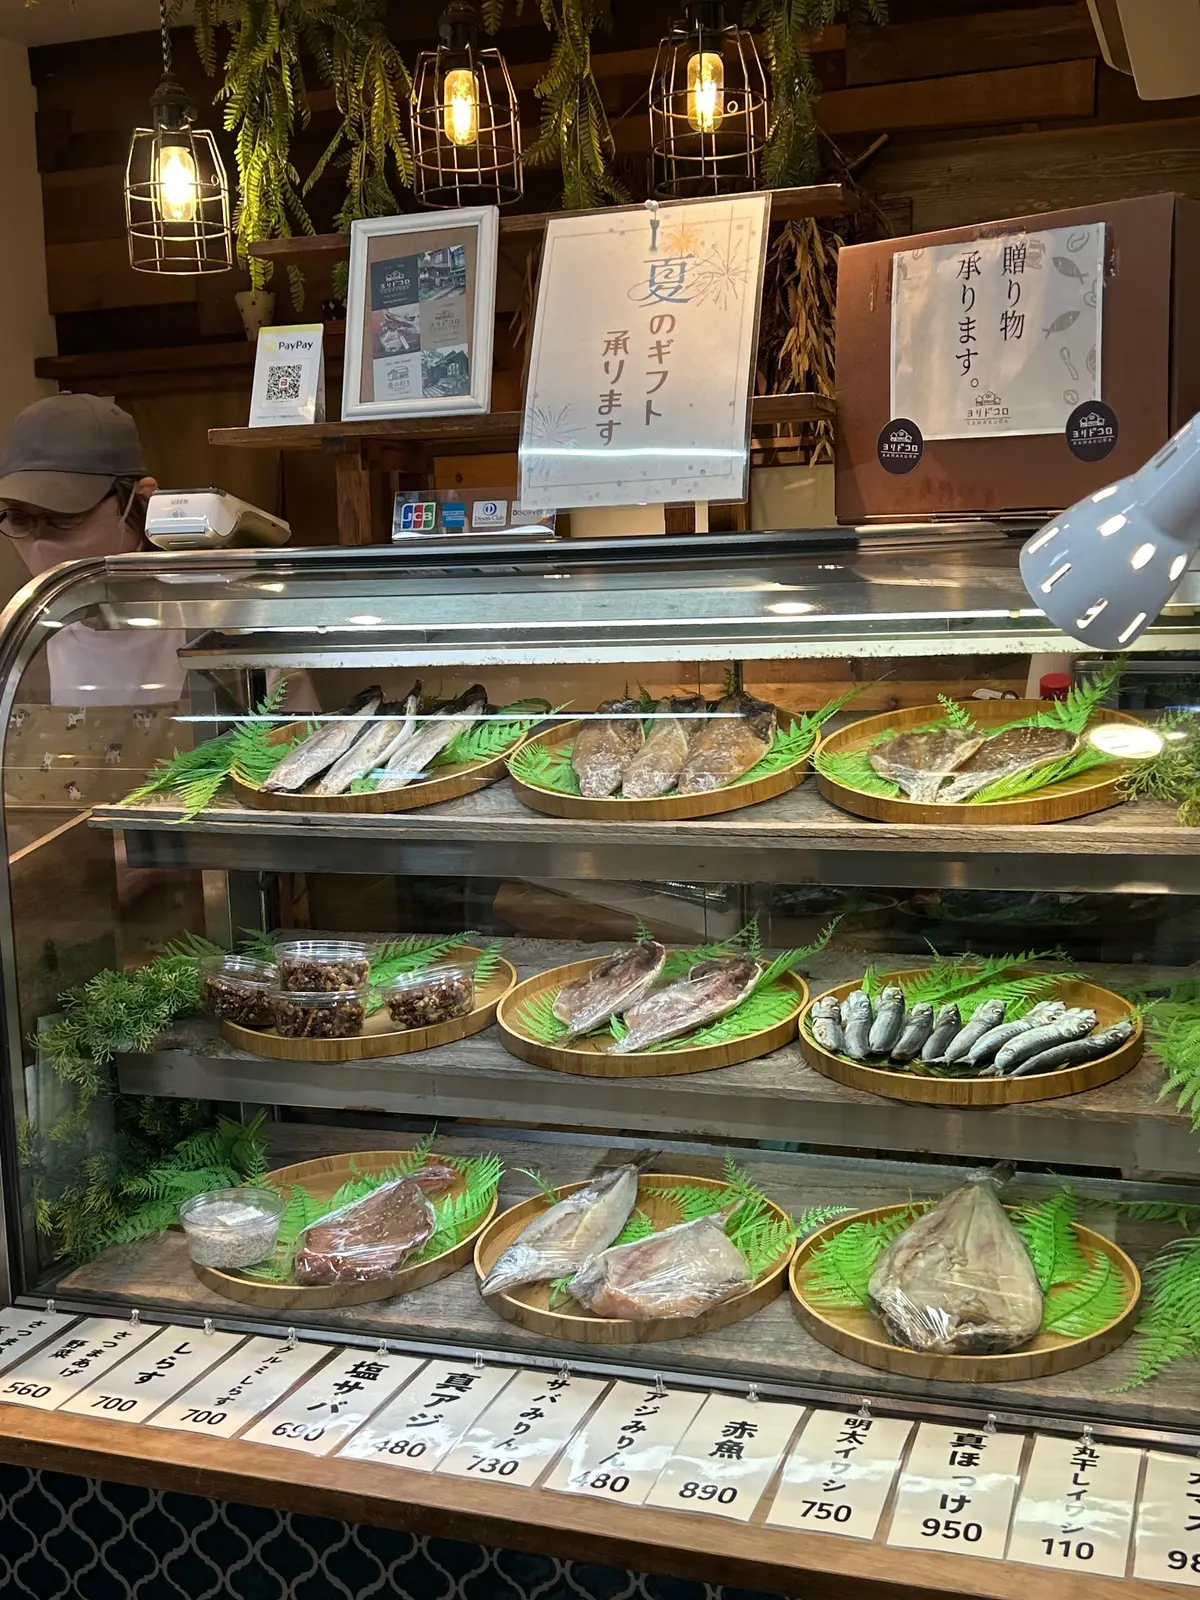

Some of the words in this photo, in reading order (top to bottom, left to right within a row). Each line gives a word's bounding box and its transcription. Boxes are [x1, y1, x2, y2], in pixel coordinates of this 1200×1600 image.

[1000, 242, 1027, 341] 贈り物
[955, 250, 982, 388] 承ります。
[278, 340, 314, 351] PayPay
[637, 253, 696, 426] 夏のギフト
[596, 329, 631, 446] 承ります
[967, 407, 1009, 418] ヨリドコロ
[1072, 426, 1113, 438] ヨリドコロ
[1072, 438, 1113, 446] KAMAKURA
[883, 443, 918, 452] ヨリドコロ
[58, 1331, 132, 1377] さつまあげ
[134, 1341, 192, 1385] しらす
[214, 1345, 294, 1406] クルミしらす
[307, 1359, 390, 1414] 塩サバ
[2, 1382, 52, 1398] 560
[406, 1371, 481, 1428] 真アジ
[90, 1395, 138, 1411] 700
[496, 1378, 571, 1451] サバみりん
[180, 1408, 227, 1425] 700
[271, 1422, 326, 1442] 690
[598, 1391, 669, 1468] アジみりん
[708, 1420, 759, 1461] 赤魚
[374, 1439, 427, 1458] 480
[822, 1417, 873, 1492] 明太イワシ
[467, 1455, 520, 1476] 730
[939, 1432, 988, 1514] 真ほっけ
[569, 1470, 630, 1493] 480
[678, 1481, 738, 1504] 890
[1060, 1445, 1100, 1533] 丸干しイワシ
[800, 1499, 852, 1522] 750
[920, 1517, 983, 1542] 950
[1042, 1538, 1095, 1560] 110
